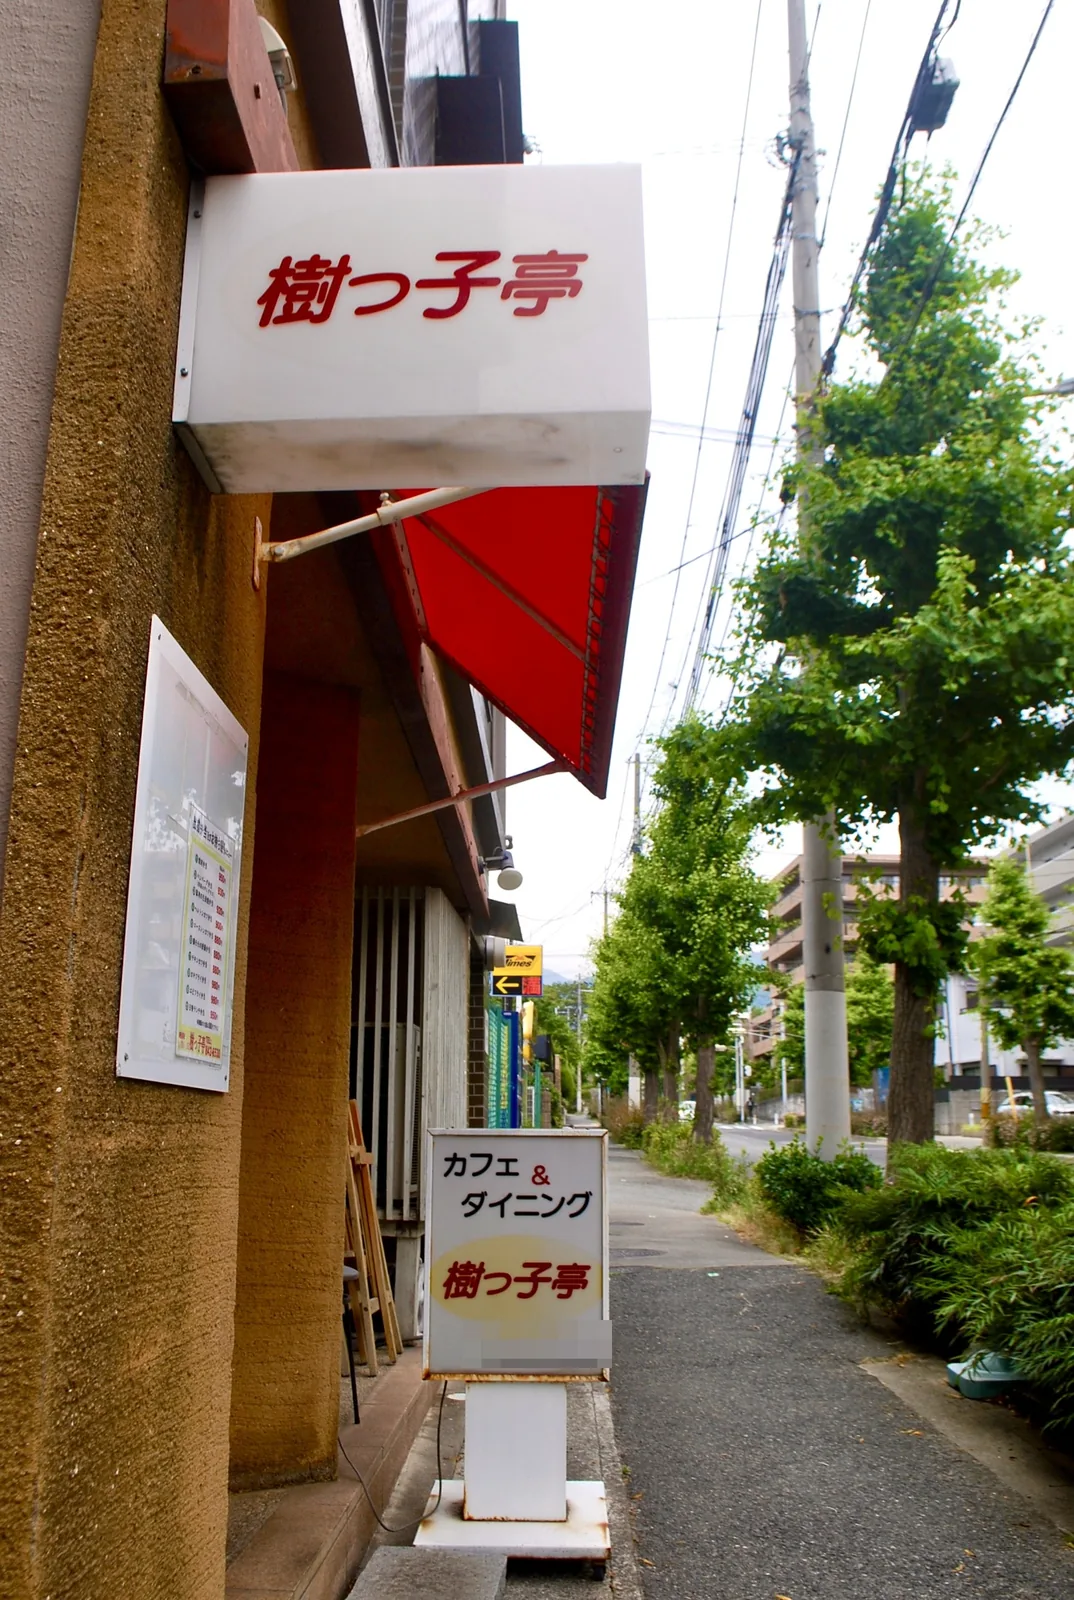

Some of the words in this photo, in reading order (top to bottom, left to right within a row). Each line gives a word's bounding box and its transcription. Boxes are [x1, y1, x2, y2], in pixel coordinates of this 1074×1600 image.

[257, 249, 589, 328] 樹っ子亭
[443, 1152, 520, 1178] カフェ
[531, 1164, 551, 1186] &
[461, 1191, 593, 1218] ダイニング
[442, 1260, 592, 1300] 樹っ子亭
